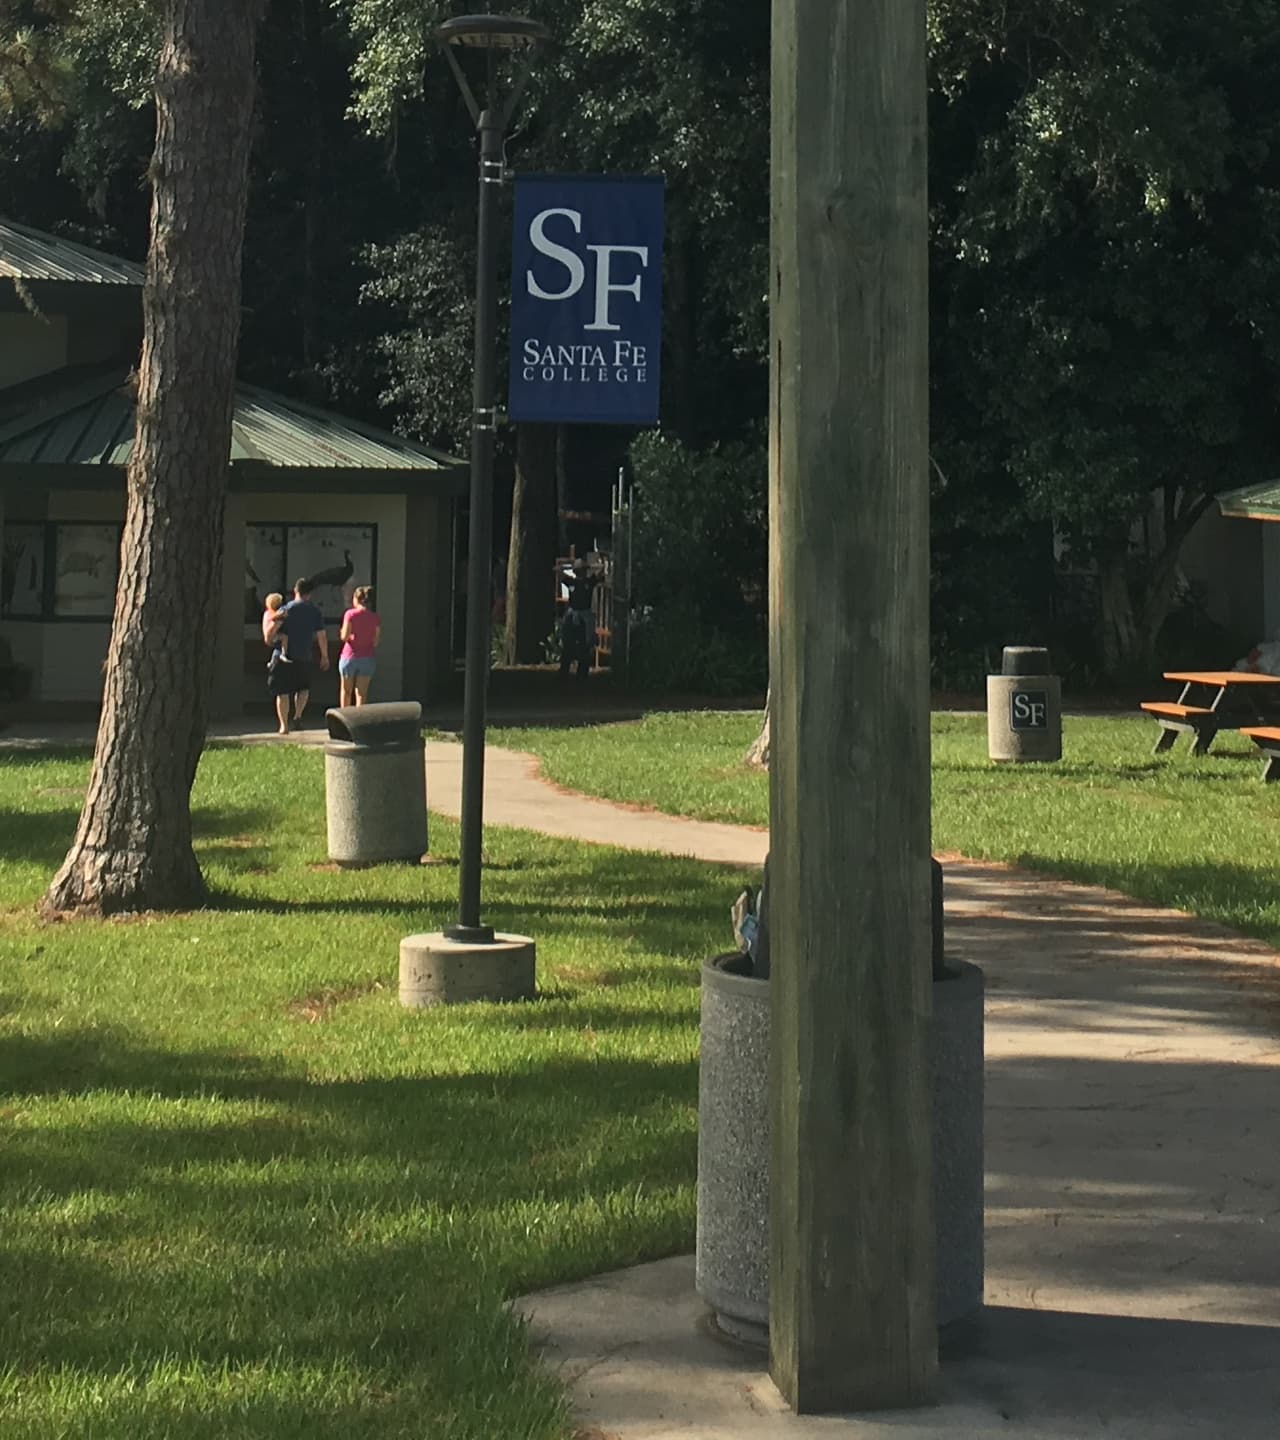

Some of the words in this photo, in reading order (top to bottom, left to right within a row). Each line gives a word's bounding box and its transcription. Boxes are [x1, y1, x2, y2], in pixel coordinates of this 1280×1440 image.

[527, 208, 648, 330] SF
[523, 367, 646, 382] COLLEGE
[1014, 694, 1044, 726] SF
